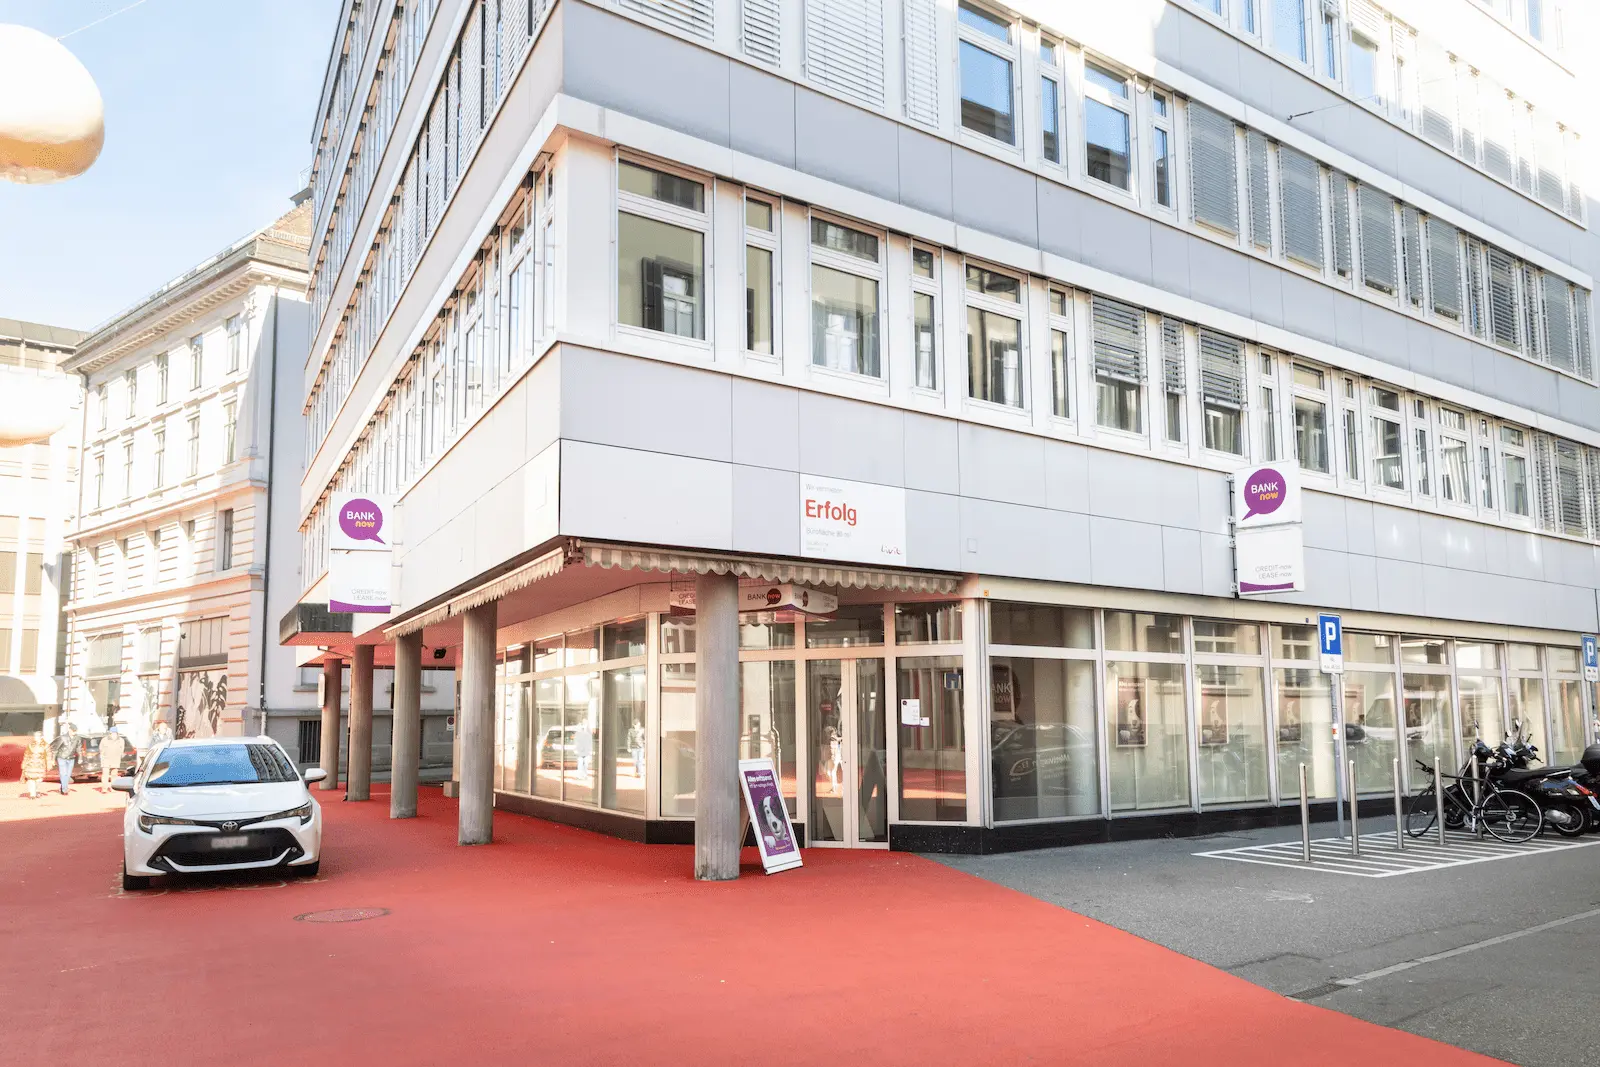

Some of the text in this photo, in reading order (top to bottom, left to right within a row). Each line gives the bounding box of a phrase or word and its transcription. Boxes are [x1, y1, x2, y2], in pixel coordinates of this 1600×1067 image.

[1251, 482, 1278, 494] BANK
[1260, 491, 1279, 501] now
[346, 511, 375, 521] BANK
[805, 499, 857, 527] Erfolg
[355, 520, 376, 528] now
[1255, 564, 1292, 573] CREDIT-now
[1259, 571, 1292, 580] LEASE-now
[747, 593, 766, 601] BANK
[1325, 621, 1336, 651] P
[1587, 641, 1594, 664] P
[991, 682, 1011, 694] ANK
